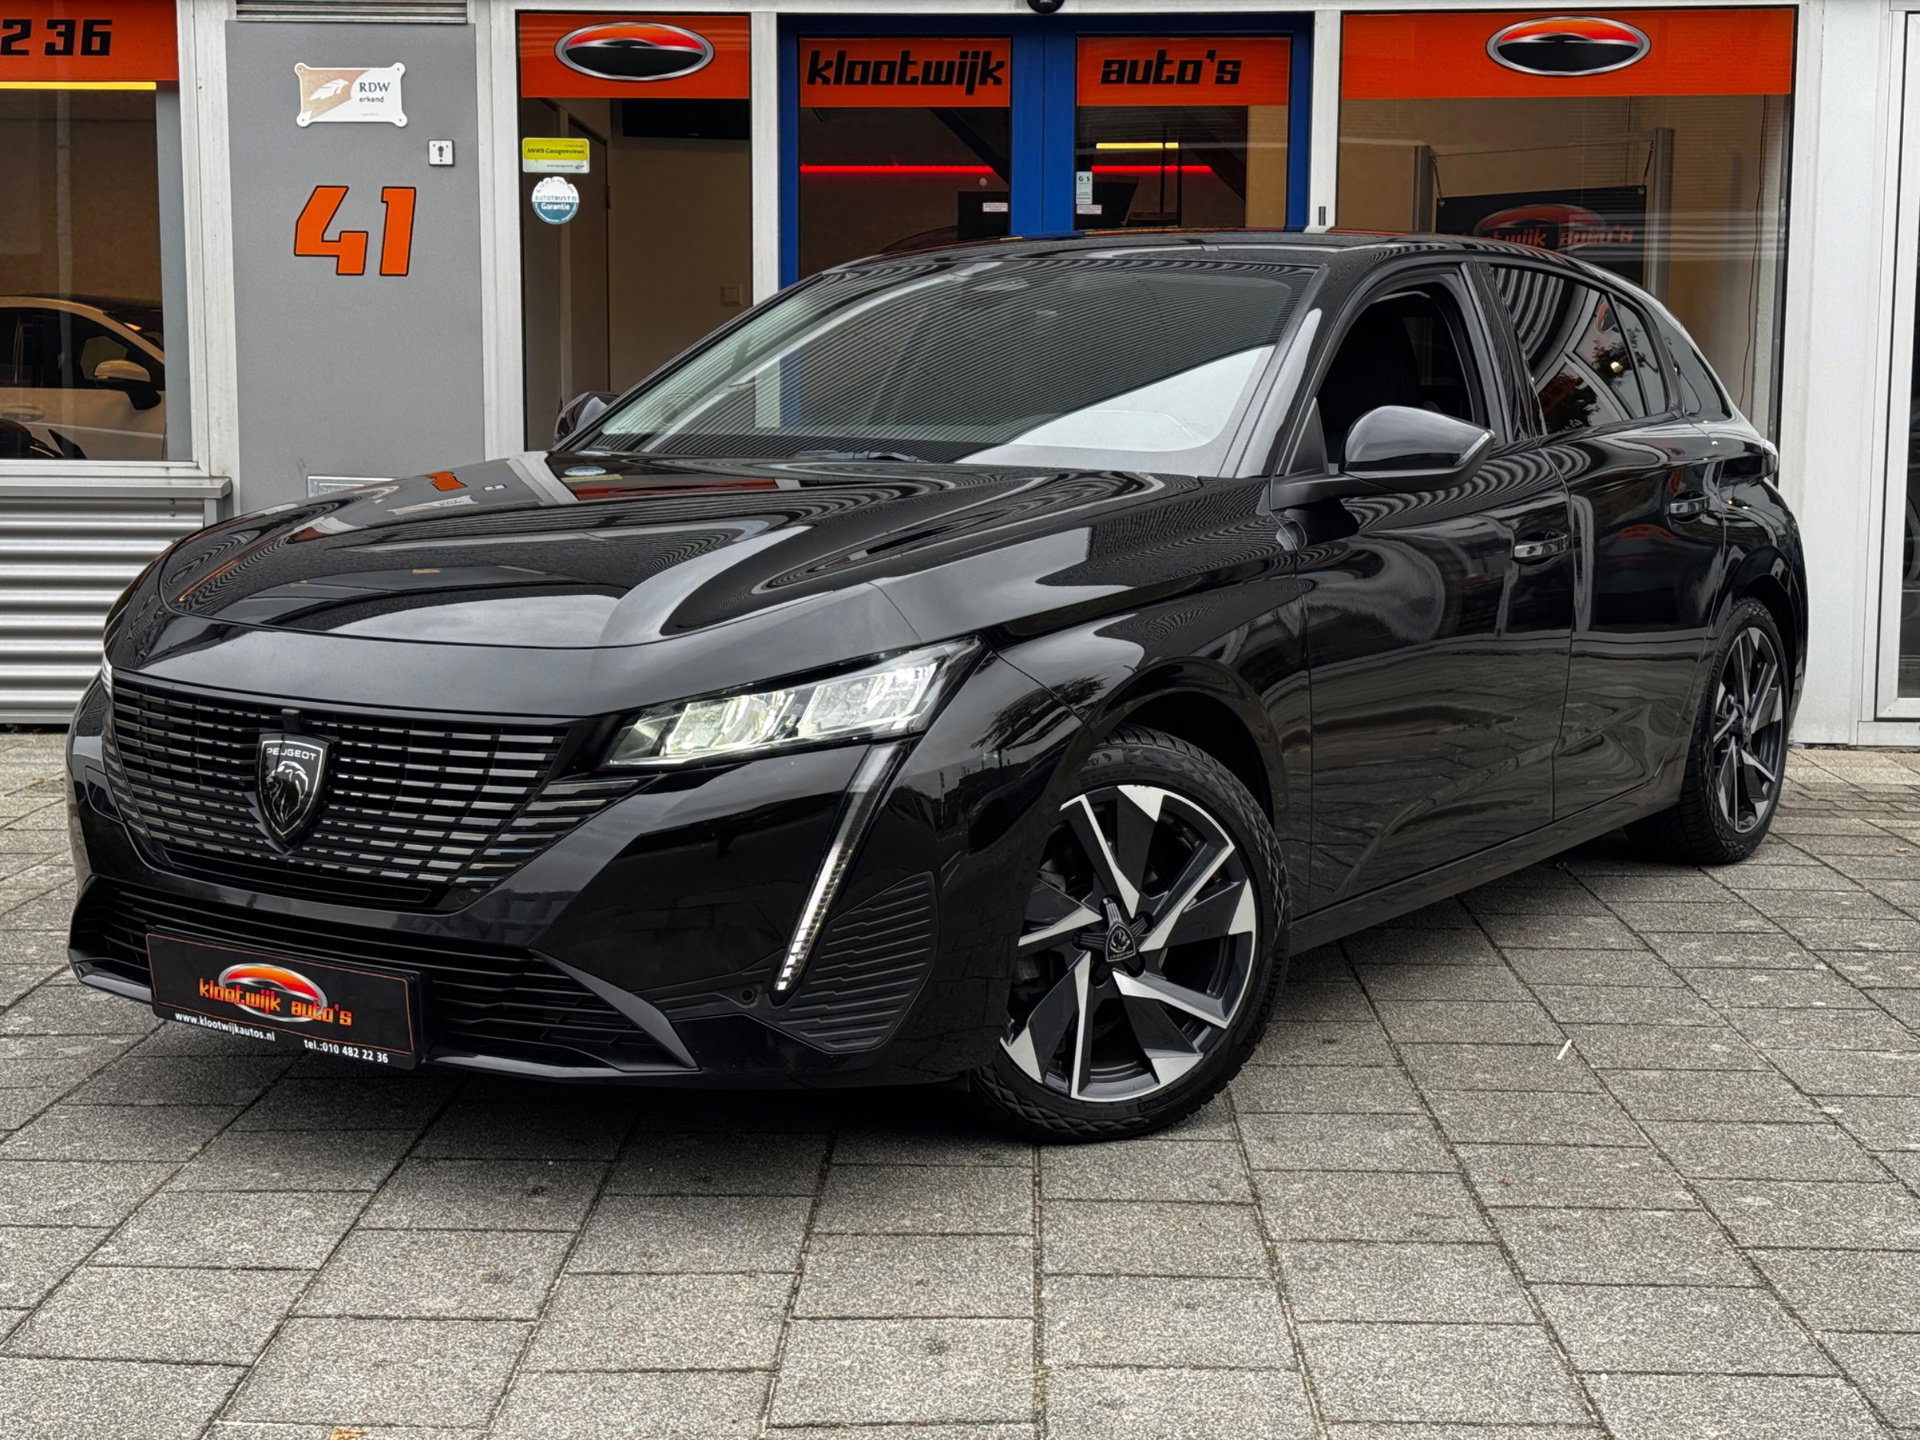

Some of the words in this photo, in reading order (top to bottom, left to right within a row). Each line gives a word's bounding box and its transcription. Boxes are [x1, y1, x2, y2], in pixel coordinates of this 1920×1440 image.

[0, 19, 32, 56] 2
[44, 19, 113, 56] 36
[806, 50, 1005, 95] klootwijk
[1100, 49, 1242, 85] auto's
[359, 82, 391, 93] RDW
[541, 203, 571, 211] Garantie
[294, 185, 416, 276] 41
[266, 747, 317, 761] PEUGEOT
[199, 978, 282, 1015] klootwijk
[290, 1000, 353, 1027] auto's
[175, 1011, 276, 1041] www.klootwijkautos.nl
[342, 1046, 360, 1059] 482
[362, 1050, 374, 1061] 22
[377, 1052, 389, 1064] 36
